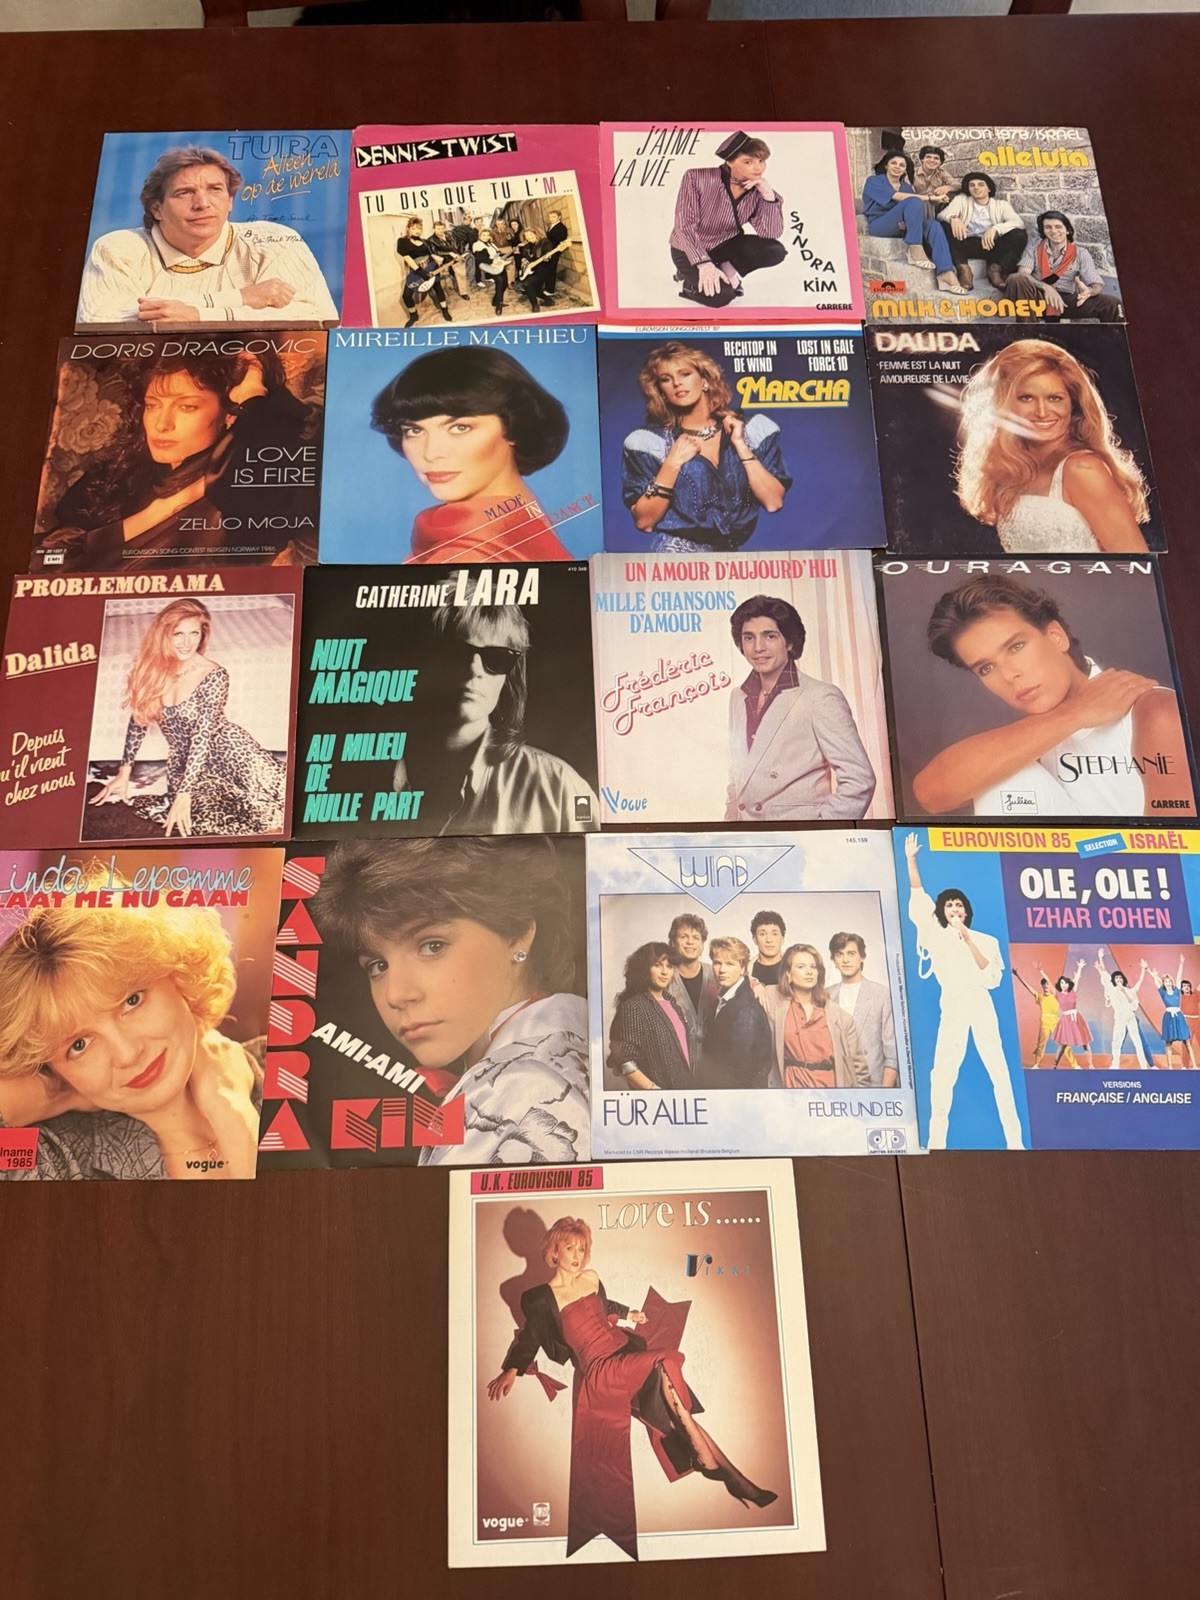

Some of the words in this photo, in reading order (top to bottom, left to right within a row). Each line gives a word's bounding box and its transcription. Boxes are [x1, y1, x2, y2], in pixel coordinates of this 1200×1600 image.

[441, 132, 516, 157] TWIST
[636, 125, 705, 156] J'AIME
[901, 128, 993, 140] EUROVISION
[228, 135, 338, 160] TURA
[978, 145, 1089, 167] alleluia
[263, 153, 313, 178] Alleen
[610, 158, 637, 187] LA
[640, 156, 675, 187] VIE
[242, 183, 262, 205] op
[265, 177, 285, 195] de
[290, 158, 341, 189] wereld
[364, 195, 385, 213] TU
[401, 190, 430, 210] DIS
[444, 185, 477, 206] QUE
[491, 181, 511, 200] TU
[789, 211, 836, 273] SANDRA
[803, 277, 838, 292] KIM
[816, 303, 853, 311] CARRERE
[872, 299, 935, 317] MILK
[939, 299, 955, 317] &
[958, 299, 1047, 318] HONEY
[335, 330, 459, 348] MIREILLE
[469, 328, 588, 346] MATHIEU
[724, 341, 764, 356] RECHTOP
[766, 340, 777, 356] IN
[797, 339, 819, 355] LOST
[821, 340, 832, 355] IN
[833, 339, 855, 354] GALE
[875, 332, 981, 352] DALIDA
[70, 342, 156, 360] DORIS
[161, 339, 317, 357] DRAGOVIC
[734, 358, 745, 373] DE
[746, 357, 773, 373] WIND
[808, 356, 836, 372] FORCE
[836, 356, 849, 371] 10
[879, 361, 910, 370] FEMME
[911, 361, 927, 370] EST
[929, 361, 941, 370] LA
[942, 361, 961, 370] NUIT
[880, 374, 932, 384] AMOUREUSE
[932, 374, 944, 384] DE
[736, 376, 851, 408] MARCHA
[245, 446, 317, 463] LOVE
[234, 468, 254, 484] IS
[263, 467, 316, 484] FIRE
[484, 493, 526, 521] MADE
[525, 503, 543, 519] IN
[624, 562, 647, 582] UN
[651, 562, 710, 581] AMOUR
[881, 560, 1153, 575] OURAGAN
[14, 574, 226, 598] PROBLEMORAMA
[355, 584, 450, 608] CATHERINE
[453, 567, 540, 606] LARA
[594, 592, 646, 612] MILLE
[650, 591, 737, 611] CHANSONS
[630, 613, 702, 633] D'AMOUR
[5, 641, 98, 677] Dalida
[310, 638, 367, 671] NUIT
[309, 670, 418, 706] MAGIQUE
[600, 652, 714, 713] Frédéric
[613, 671, 732, 736] François
[12, 729, 65, 757] Depuis
[306, 734, 336, 762] AU
[341, 732, 407, 761] MILIEU
[0, 754, 28, 782] u'il
[30, 746, 72, 774] vient
[1058, 752, 1176, 783] STEPHANIE
[5, 781, 39, 806] chez
[41, 771, 76, 794] nous
[304, 764, 332, 792] DE
[303, 793, 363, 823] NULLE
[371, 791, 425, 821] PART
[1151, 800, 1190, 809] CARRERE
[942, 831, 1047, 848] EUROVISION
[1051, 832, 1071, 848] 85
[1084, 838, 1118, 851] SELECTION
[1129, 831, 1188, 849] ISRAËL
[0, 854, 89, 895] inda
[99, 854, 255, 905] Lepomme
[679, 855, 749, 888] WIND
[0, 889, 66, 908] AAT
[74, 890, 113, 908] ME
[121, 890, 160, 907] NU
[165, 890, 249, 907] GAAN
[1026, 907, 1092, 928] IZHAR
[1099, 907, 1171, 929] COHEN
[258, 856, 326, 1152] SANDRA
[310, 1021, 427, 1095] AMI-AMI
[603, 1093, 649, 1126] FÜR
[652, 1098, 708, 1126] ALLE
[808, 1101, 850, 1117] FEUER
[850, 1101, 884, 1117] UND
[885, 1101, 904, 1117] EIS
[1056, 1092, 1124, 1106] FRANÇAISE
[1132, 1092, 1192, 1104] ANGLAISE
[330, 1093, 465, 1153] KIM
[6, 1158, 33, 1168] 1985
[186, 1160, 224, 1173] vogue
[480, 1173, 504, 1191] U.K.
[507, 1171, 573, 1190] EUROVISION
[577, 1169, 594, 1187] 85
[482, 1517, 525, 1532] vogue
